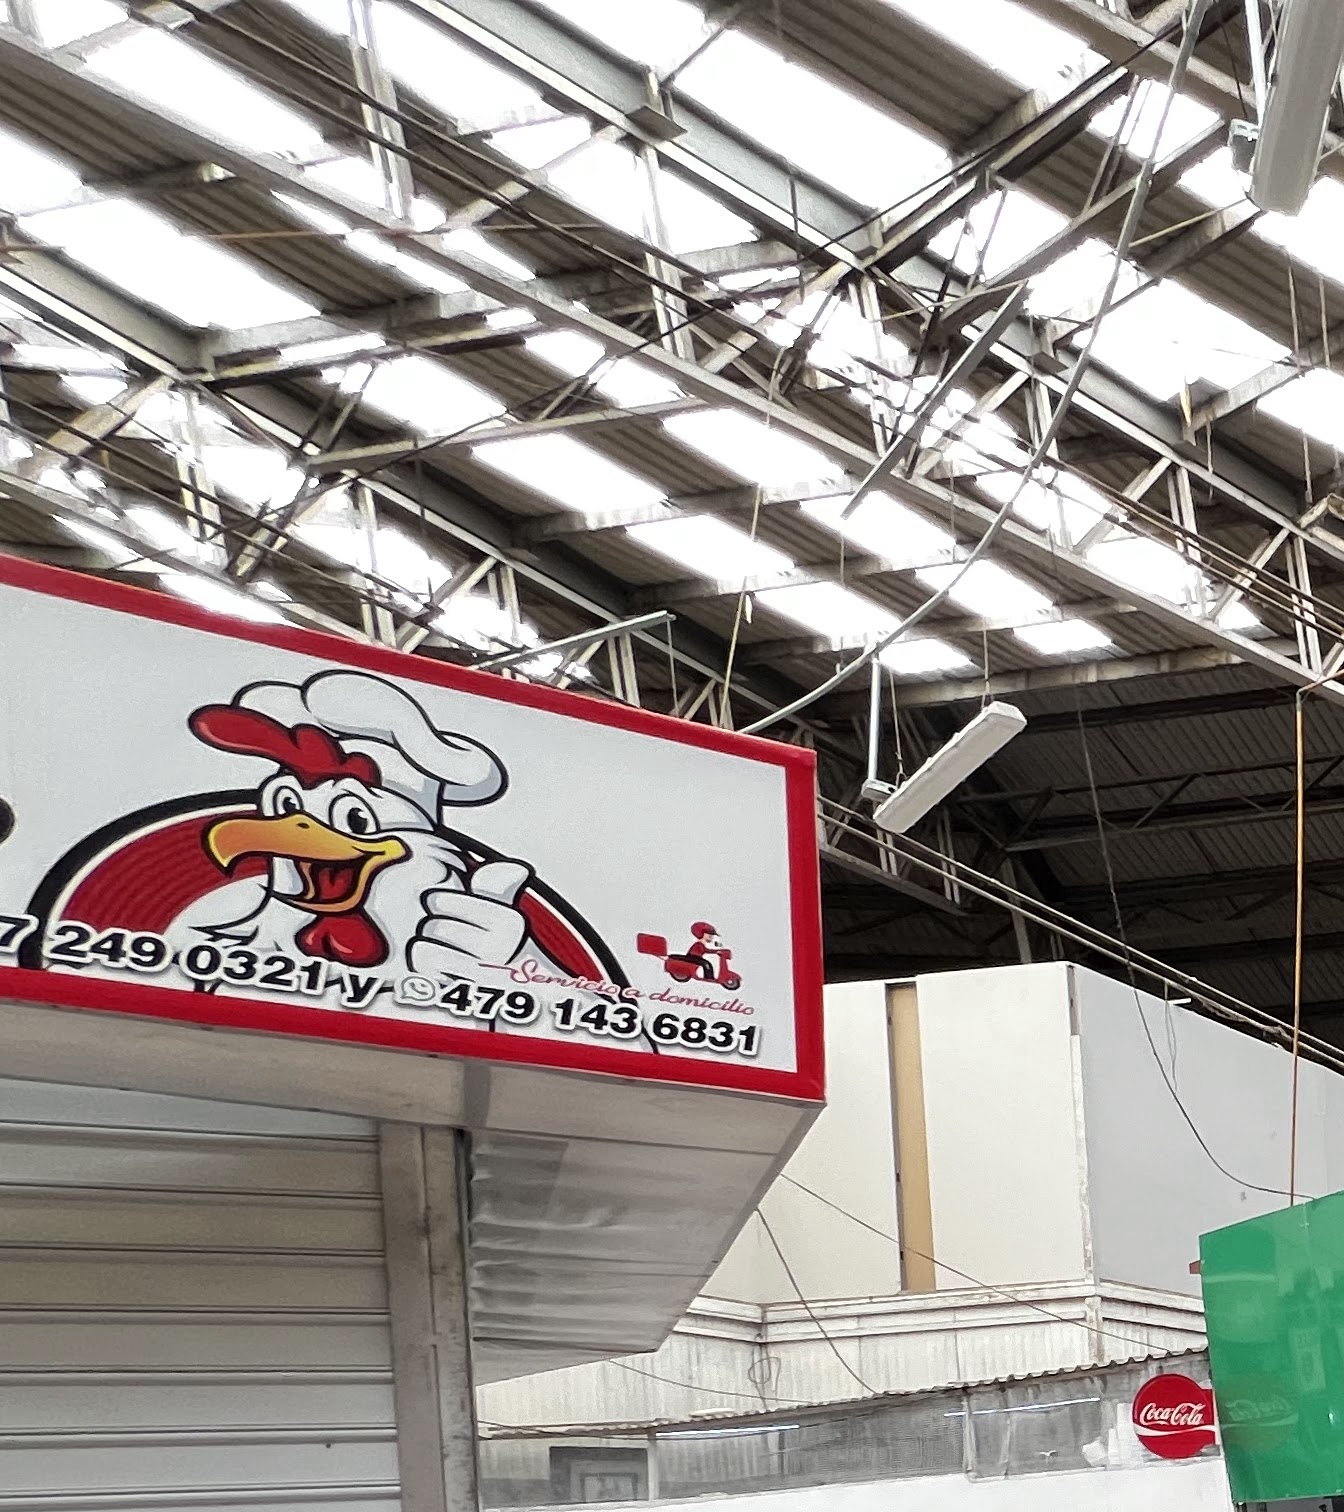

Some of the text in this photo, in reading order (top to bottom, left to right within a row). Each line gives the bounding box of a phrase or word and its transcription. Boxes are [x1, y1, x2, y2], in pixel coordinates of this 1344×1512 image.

[50, 924, 167, 967] 249
[186, 945, 324, 991] 0321
[348, 974, 378, 1003] y
[441, 983, 536, 1020] 479
[555, 998, 638, 1034] 143
[652, 1013, 759, 1052] 6831
[480, 959, 755, 1016] Servicio a domicilio
